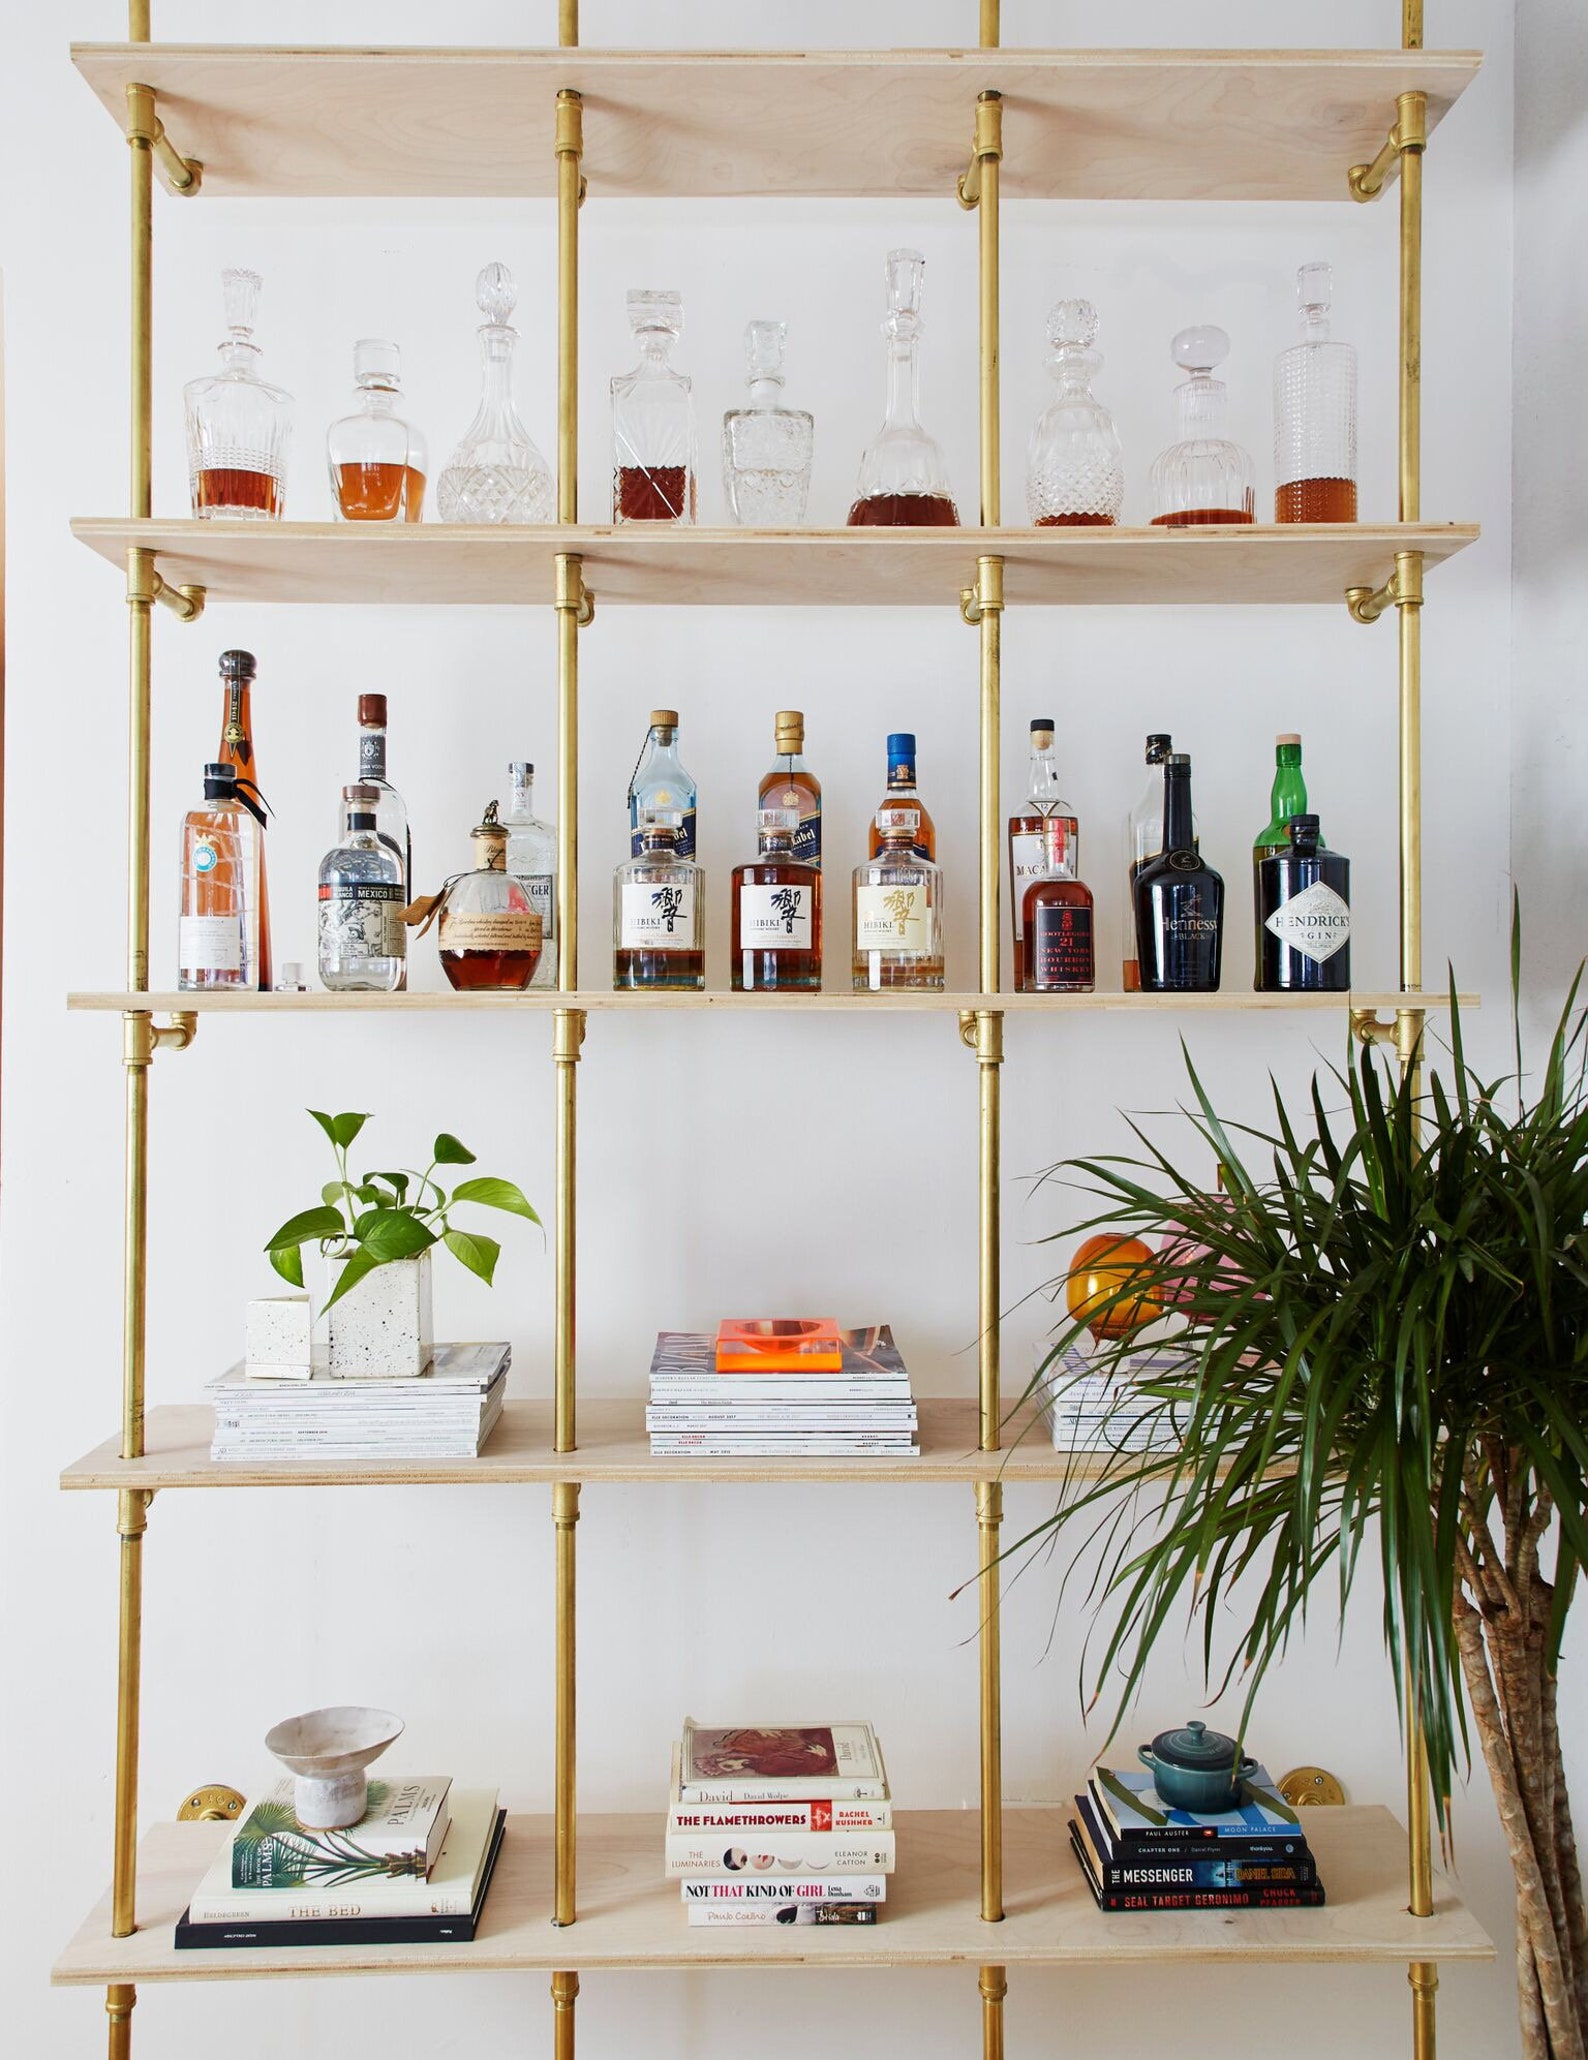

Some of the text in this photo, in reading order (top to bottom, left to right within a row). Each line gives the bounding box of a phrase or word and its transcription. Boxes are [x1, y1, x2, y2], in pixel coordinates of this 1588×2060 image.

[358, 890, 388, 899] MEXICO
[863, 921, 894, 929] HIBIKI
[1307, 931, 1331, 940] GIN
[1060, 938, 1074, 946] 21
[699, 1789, 733, 1802] David
[743, 1792, 764, 1800] David
[386, 1785, 421, 1825] PALMS
[677, 1814, 806, 1826] THE FLAMETHROWERS
[688, 1851, 703, 1859] THE
[834, 1850, 868, 1858] ELEANOR
[262, 1843, 273, 1887] PALMS
[671, 1860, 720, 1868] LUMINARIES
[836, 1858, 866, 1866] CATTON
[1111, 1868, 1194, 1884] THE MESSENGER
[1235, 1867, 1268, 1881] DANIEL
[686, 1885, 826, 1898] NOT THAT KIND OF GIRL
[1263, 1888, 1297, 1897] CHUCK
[1124, 1892, 1250, 1908] SEAL TARGET GERONIMO
[288, 1903, 361, 1918] THE BED
[708, 1911, 766, 1920] Paulo Coelho
